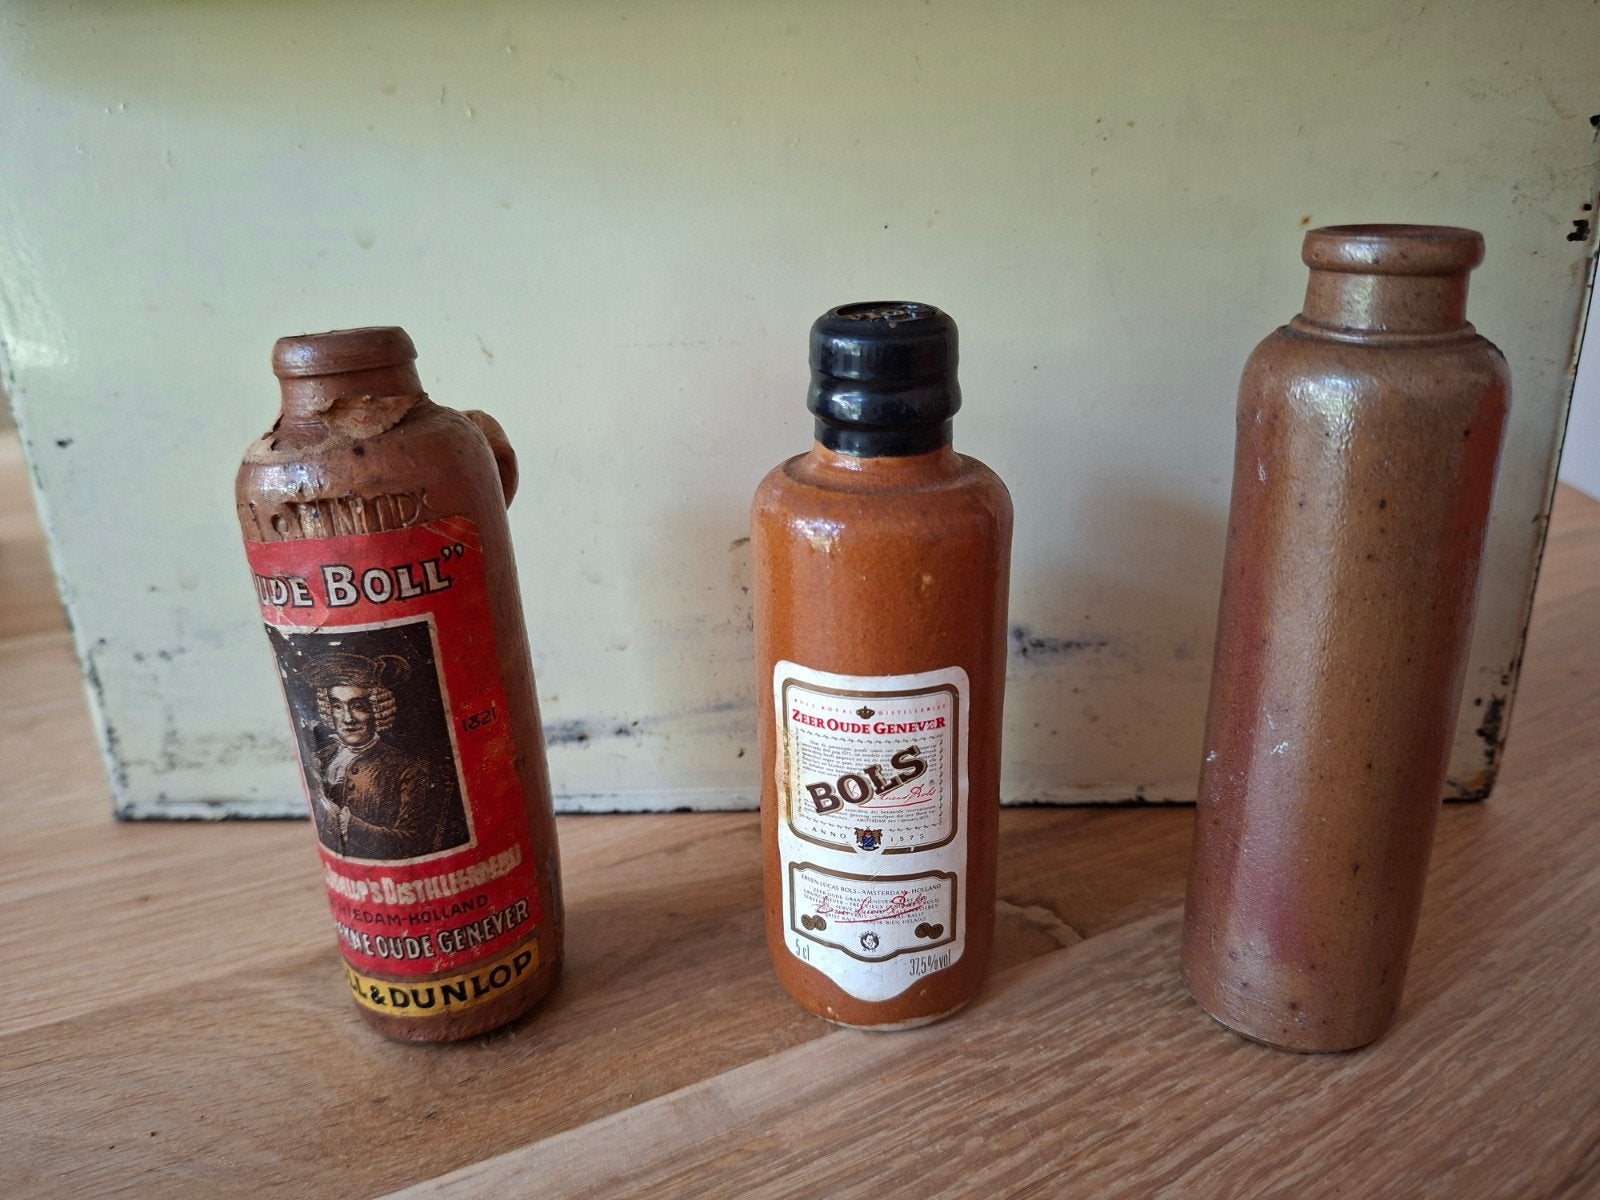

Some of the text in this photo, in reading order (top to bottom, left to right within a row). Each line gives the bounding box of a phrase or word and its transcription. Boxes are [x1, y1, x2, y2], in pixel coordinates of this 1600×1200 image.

[255, 573, 315, 609] UDE
[462, 706, 497, 733] 1821
[792, 708, 946, 735] ZEER OUDE GENEVER
[806, 745, 928, 816] BOLS
[811, 826, 847, 840] ANNO
[840, 886, 857, 894] BOLS
[911, 883, 942, 894] HOLLAND
[332, 893, 489, 927] HIEDAM-HOLLAND
[375, 934, 436, 961] OUDE
[437, 897, 532, 955] GENEVER
[795, 938, 801, 957] 5
